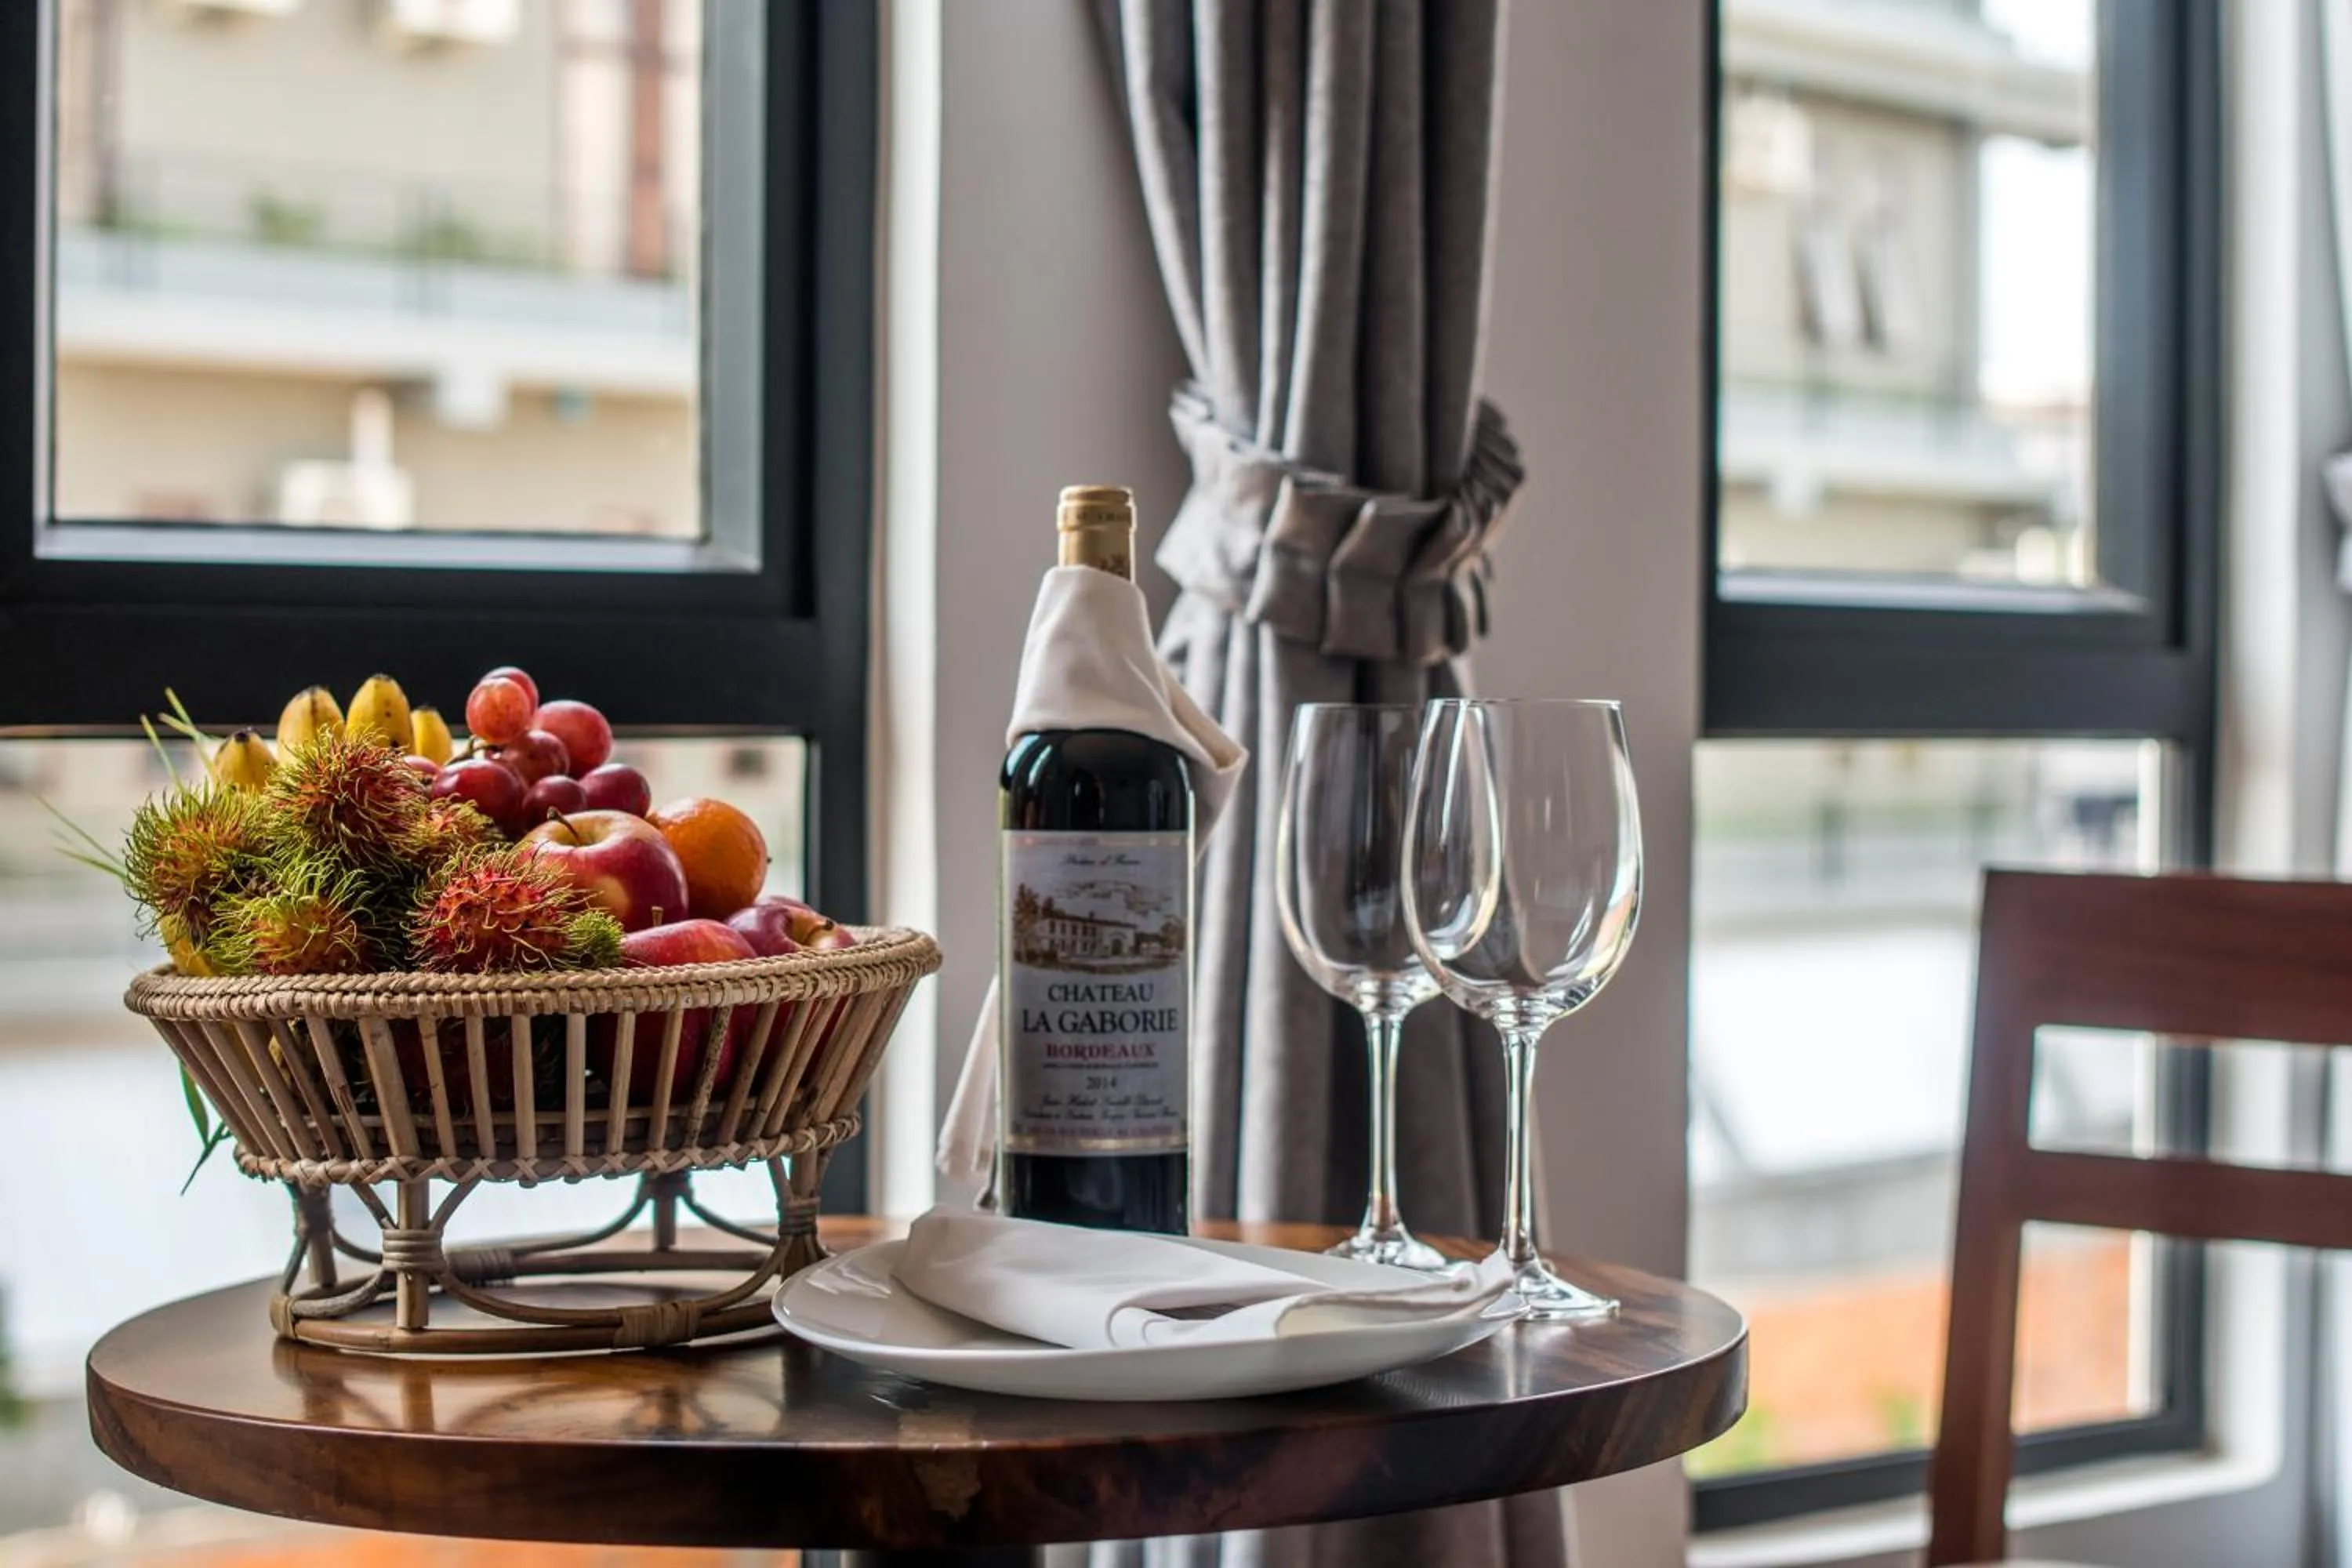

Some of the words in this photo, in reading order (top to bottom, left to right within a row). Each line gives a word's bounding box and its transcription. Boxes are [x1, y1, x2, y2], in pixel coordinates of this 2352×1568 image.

[1047, 983, 1154, 1003] CHATEAU
[1022, 1008, 1052, 1033] LA
[1058, 1007, 1179, 1034] GABORIE
[1045, 1043, 1156, 1058] BORDEAUX
[1085, 1076, 1118, 1090] 2014
